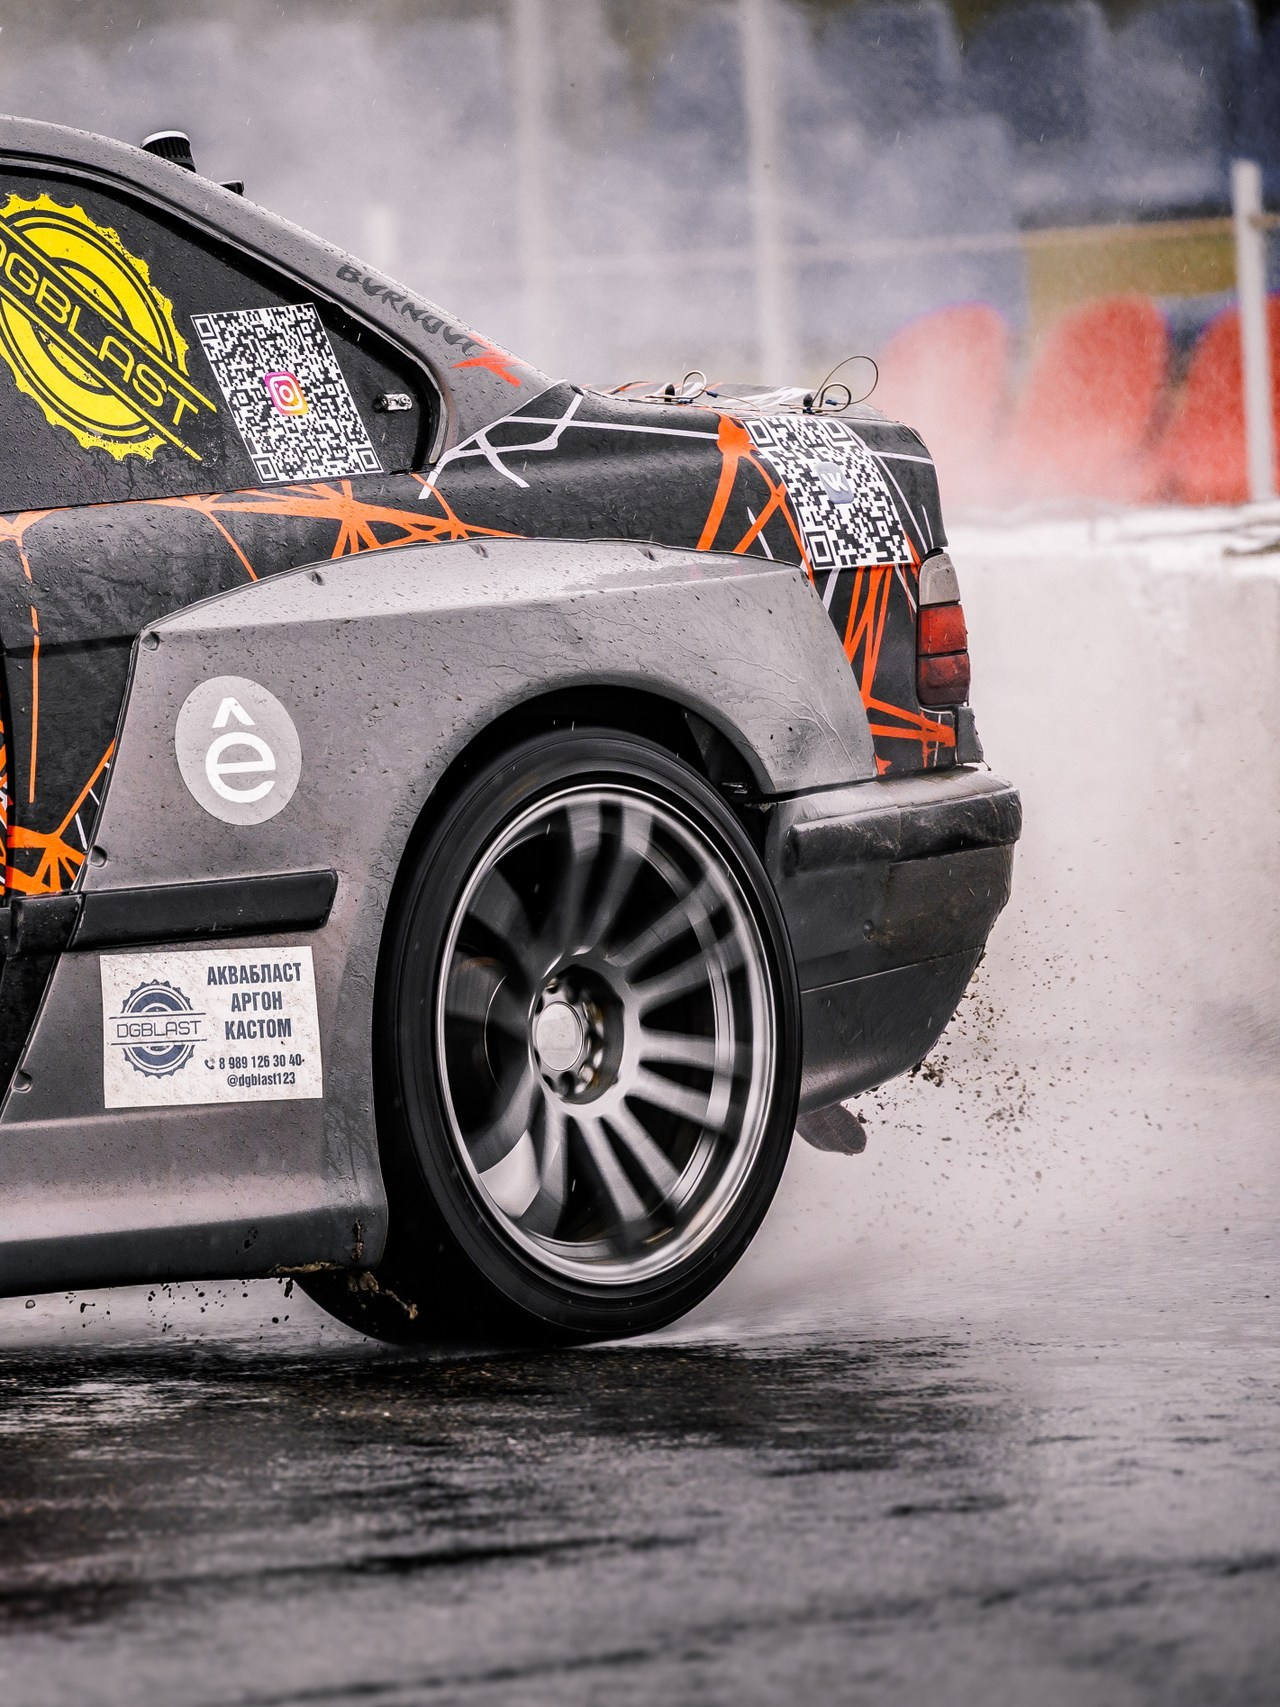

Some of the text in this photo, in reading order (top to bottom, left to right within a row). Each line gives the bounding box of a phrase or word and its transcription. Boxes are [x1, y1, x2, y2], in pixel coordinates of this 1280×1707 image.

[207, 963, 302, 986] АКВАБЛАСТ
[231, 991, 283, 1012] АРГОН
[116, 1020, 202, 1038] DGBLAST
[224, 1018, 292, 1040] КАСТОМ
[219, 1053, 302, 1070] 8 989 126 30 40
[227, 1072, 296, 1088] @dgblast123
